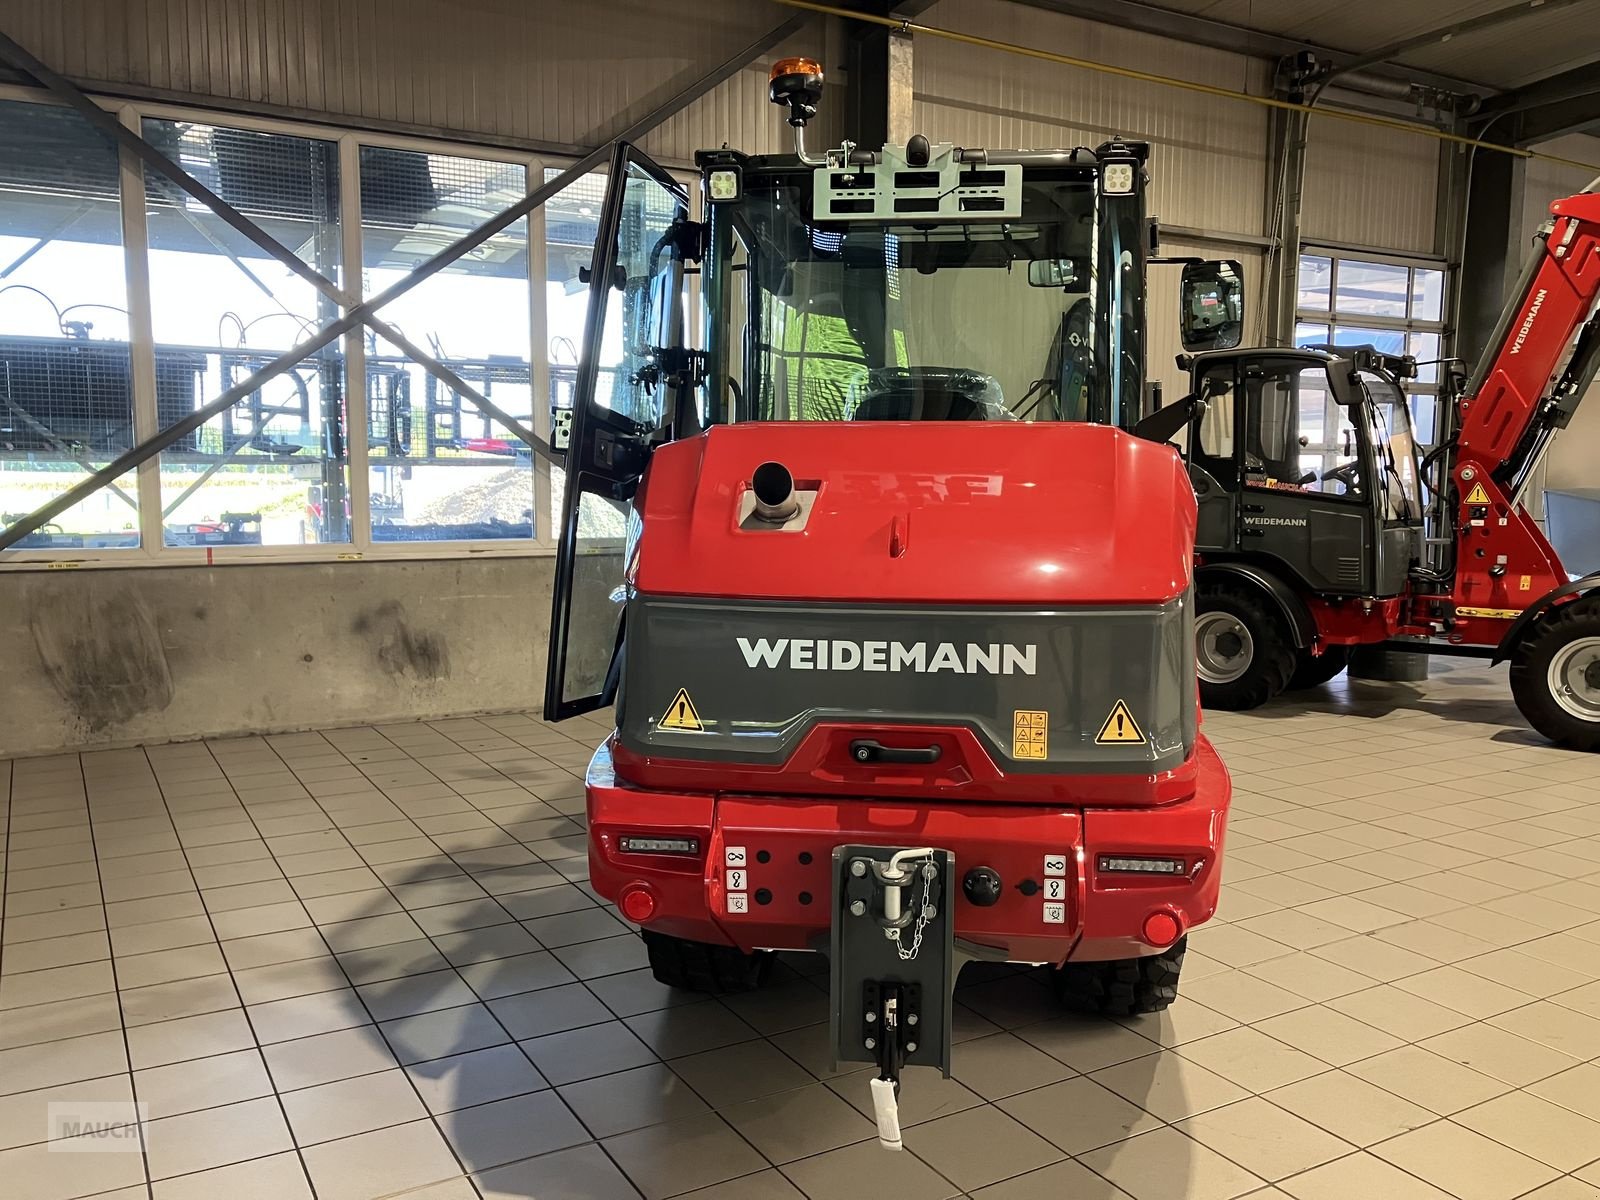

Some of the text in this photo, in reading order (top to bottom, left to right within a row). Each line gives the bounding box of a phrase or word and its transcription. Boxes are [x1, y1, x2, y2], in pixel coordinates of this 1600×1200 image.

[1510, 289, 1548, 354] WEIDEMANN
[1243, 517, 1307, 527] WEIDEMANN
[736, 637, 1037, 675] WEIDEMANN
